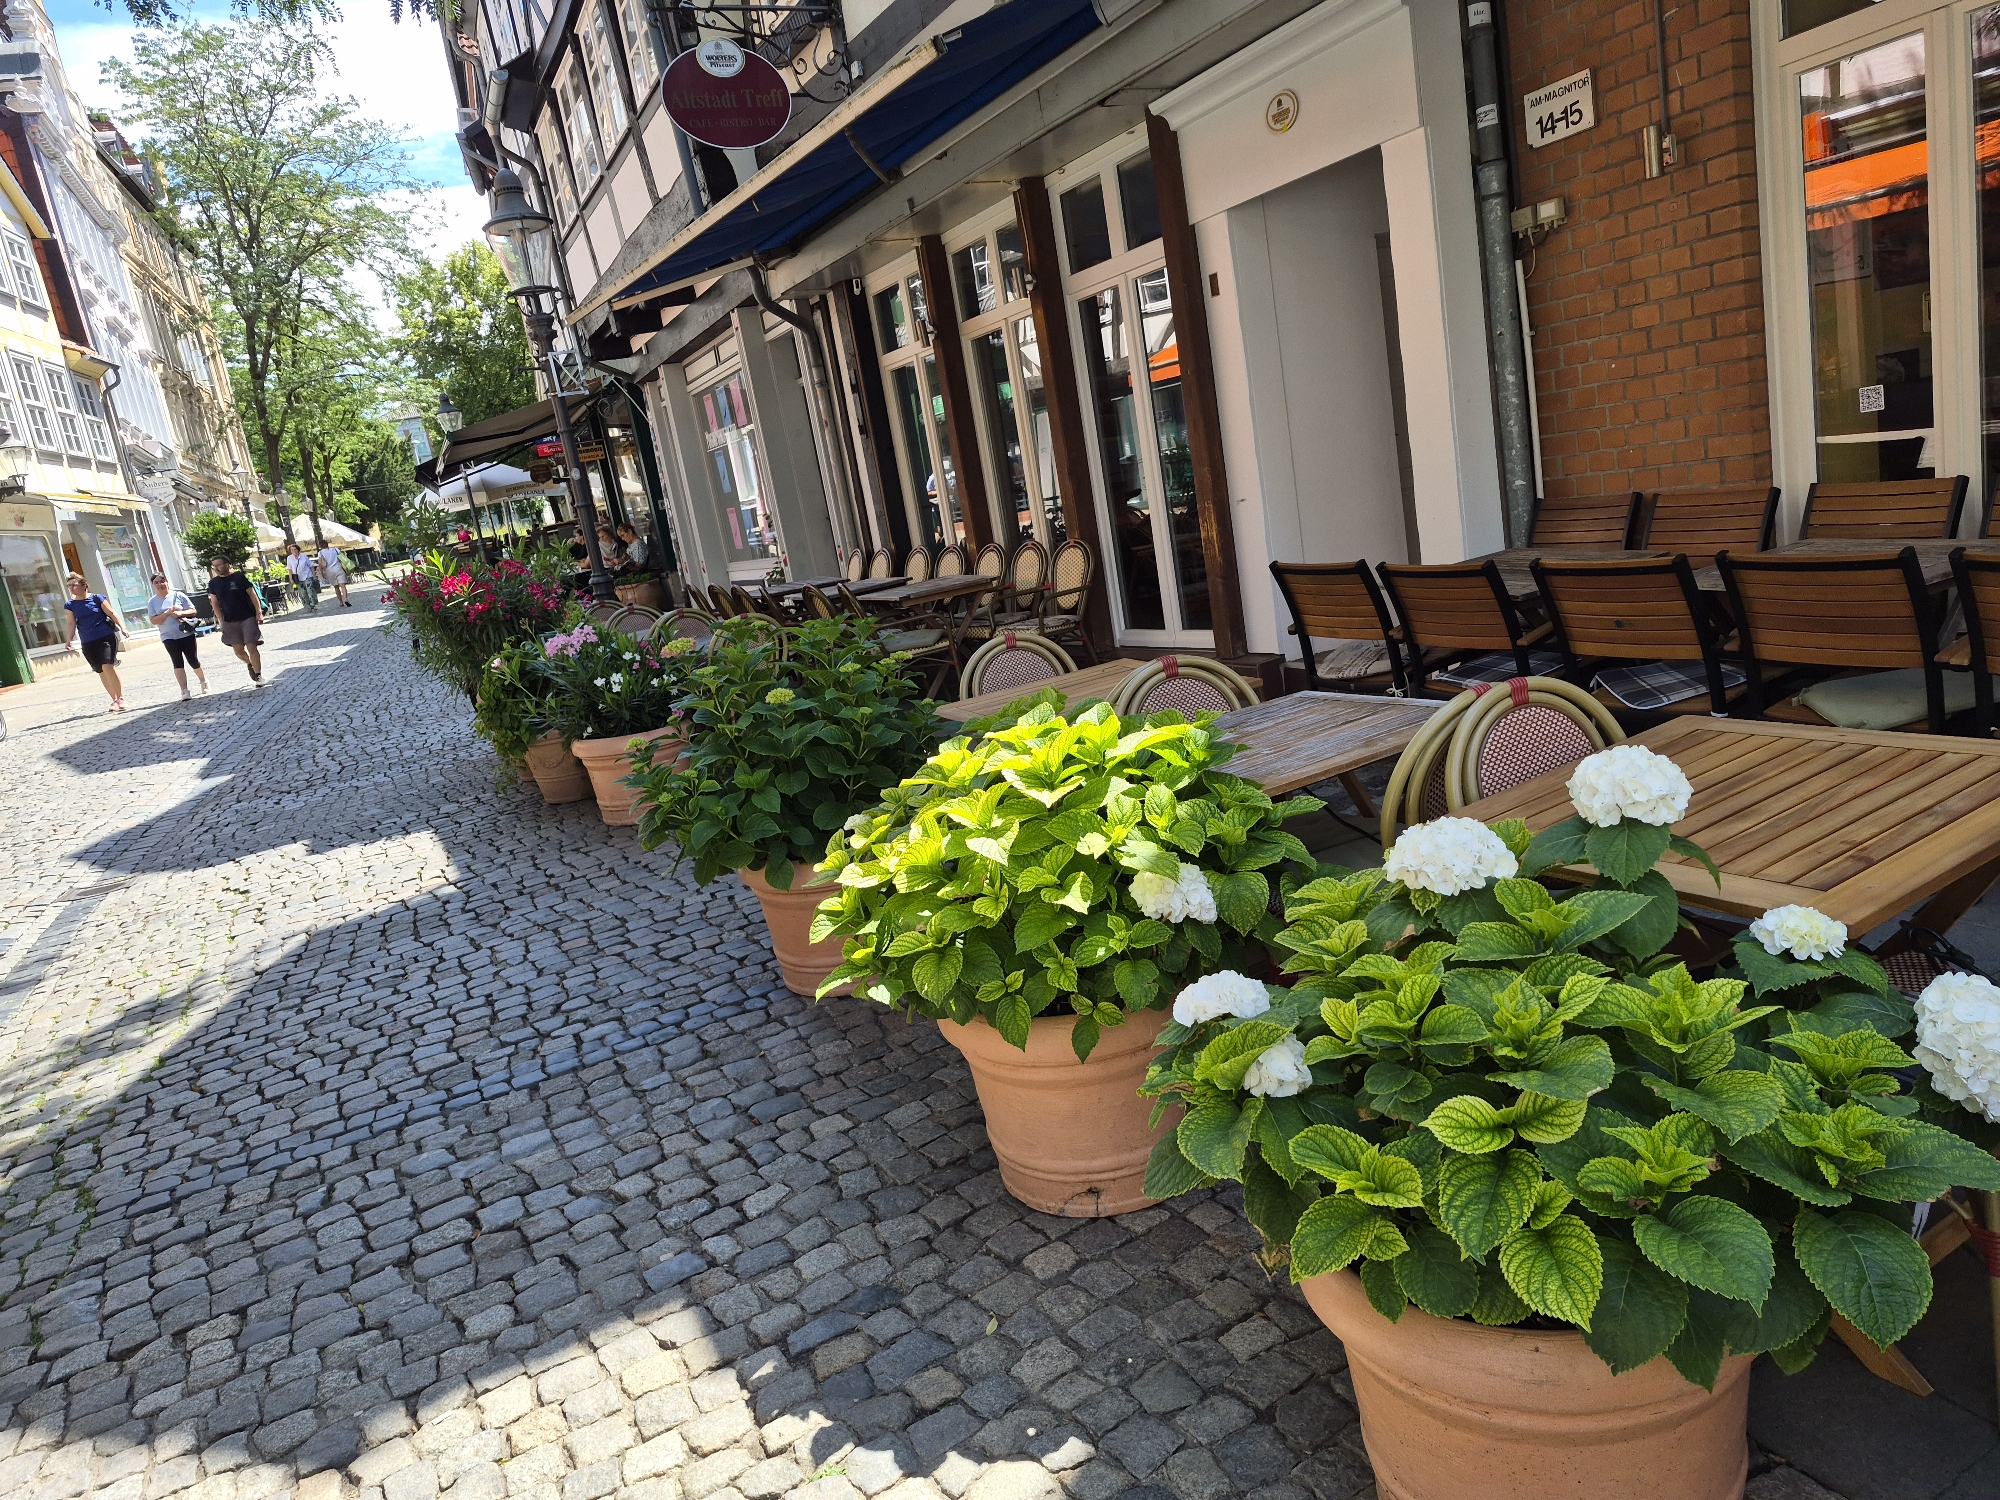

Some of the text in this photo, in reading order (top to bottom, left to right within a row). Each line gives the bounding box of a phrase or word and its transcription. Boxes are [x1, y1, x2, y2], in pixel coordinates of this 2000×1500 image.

[705, 54, 737, 62] WOLTERS
[671, 88, 784, 110] Altstadt Treff
[720, 117, 753, 128] BISTRO
[758, 116, 777, 127] BAR
[1535, 99, 1584, 139] 14-15
